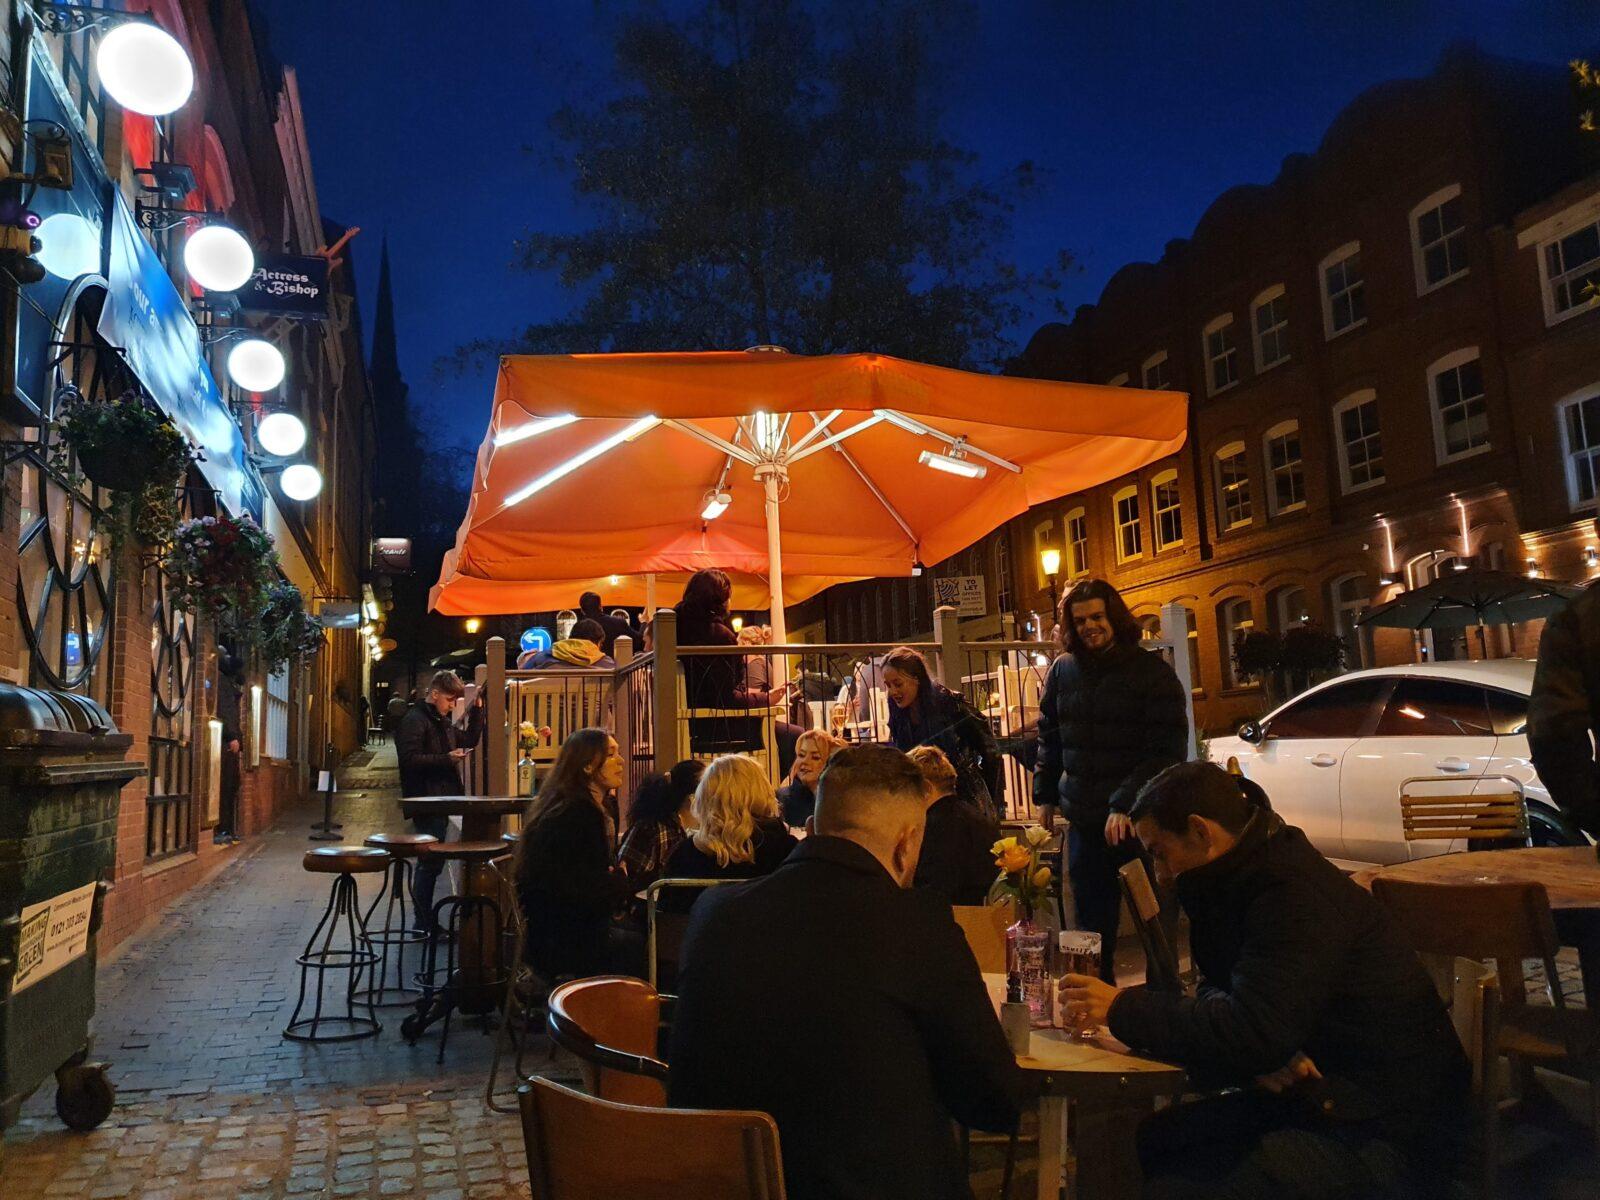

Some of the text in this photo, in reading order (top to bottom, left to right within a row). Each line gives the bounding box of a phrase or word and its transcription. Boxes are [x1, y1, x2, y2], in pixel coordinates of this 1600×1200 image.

[251, 267, 309, 283] Actress
[254, 280, 319, 298] & Bishop
[51, 921, 65, 937] 0121
[19, 942, 40, 974] GREEN
